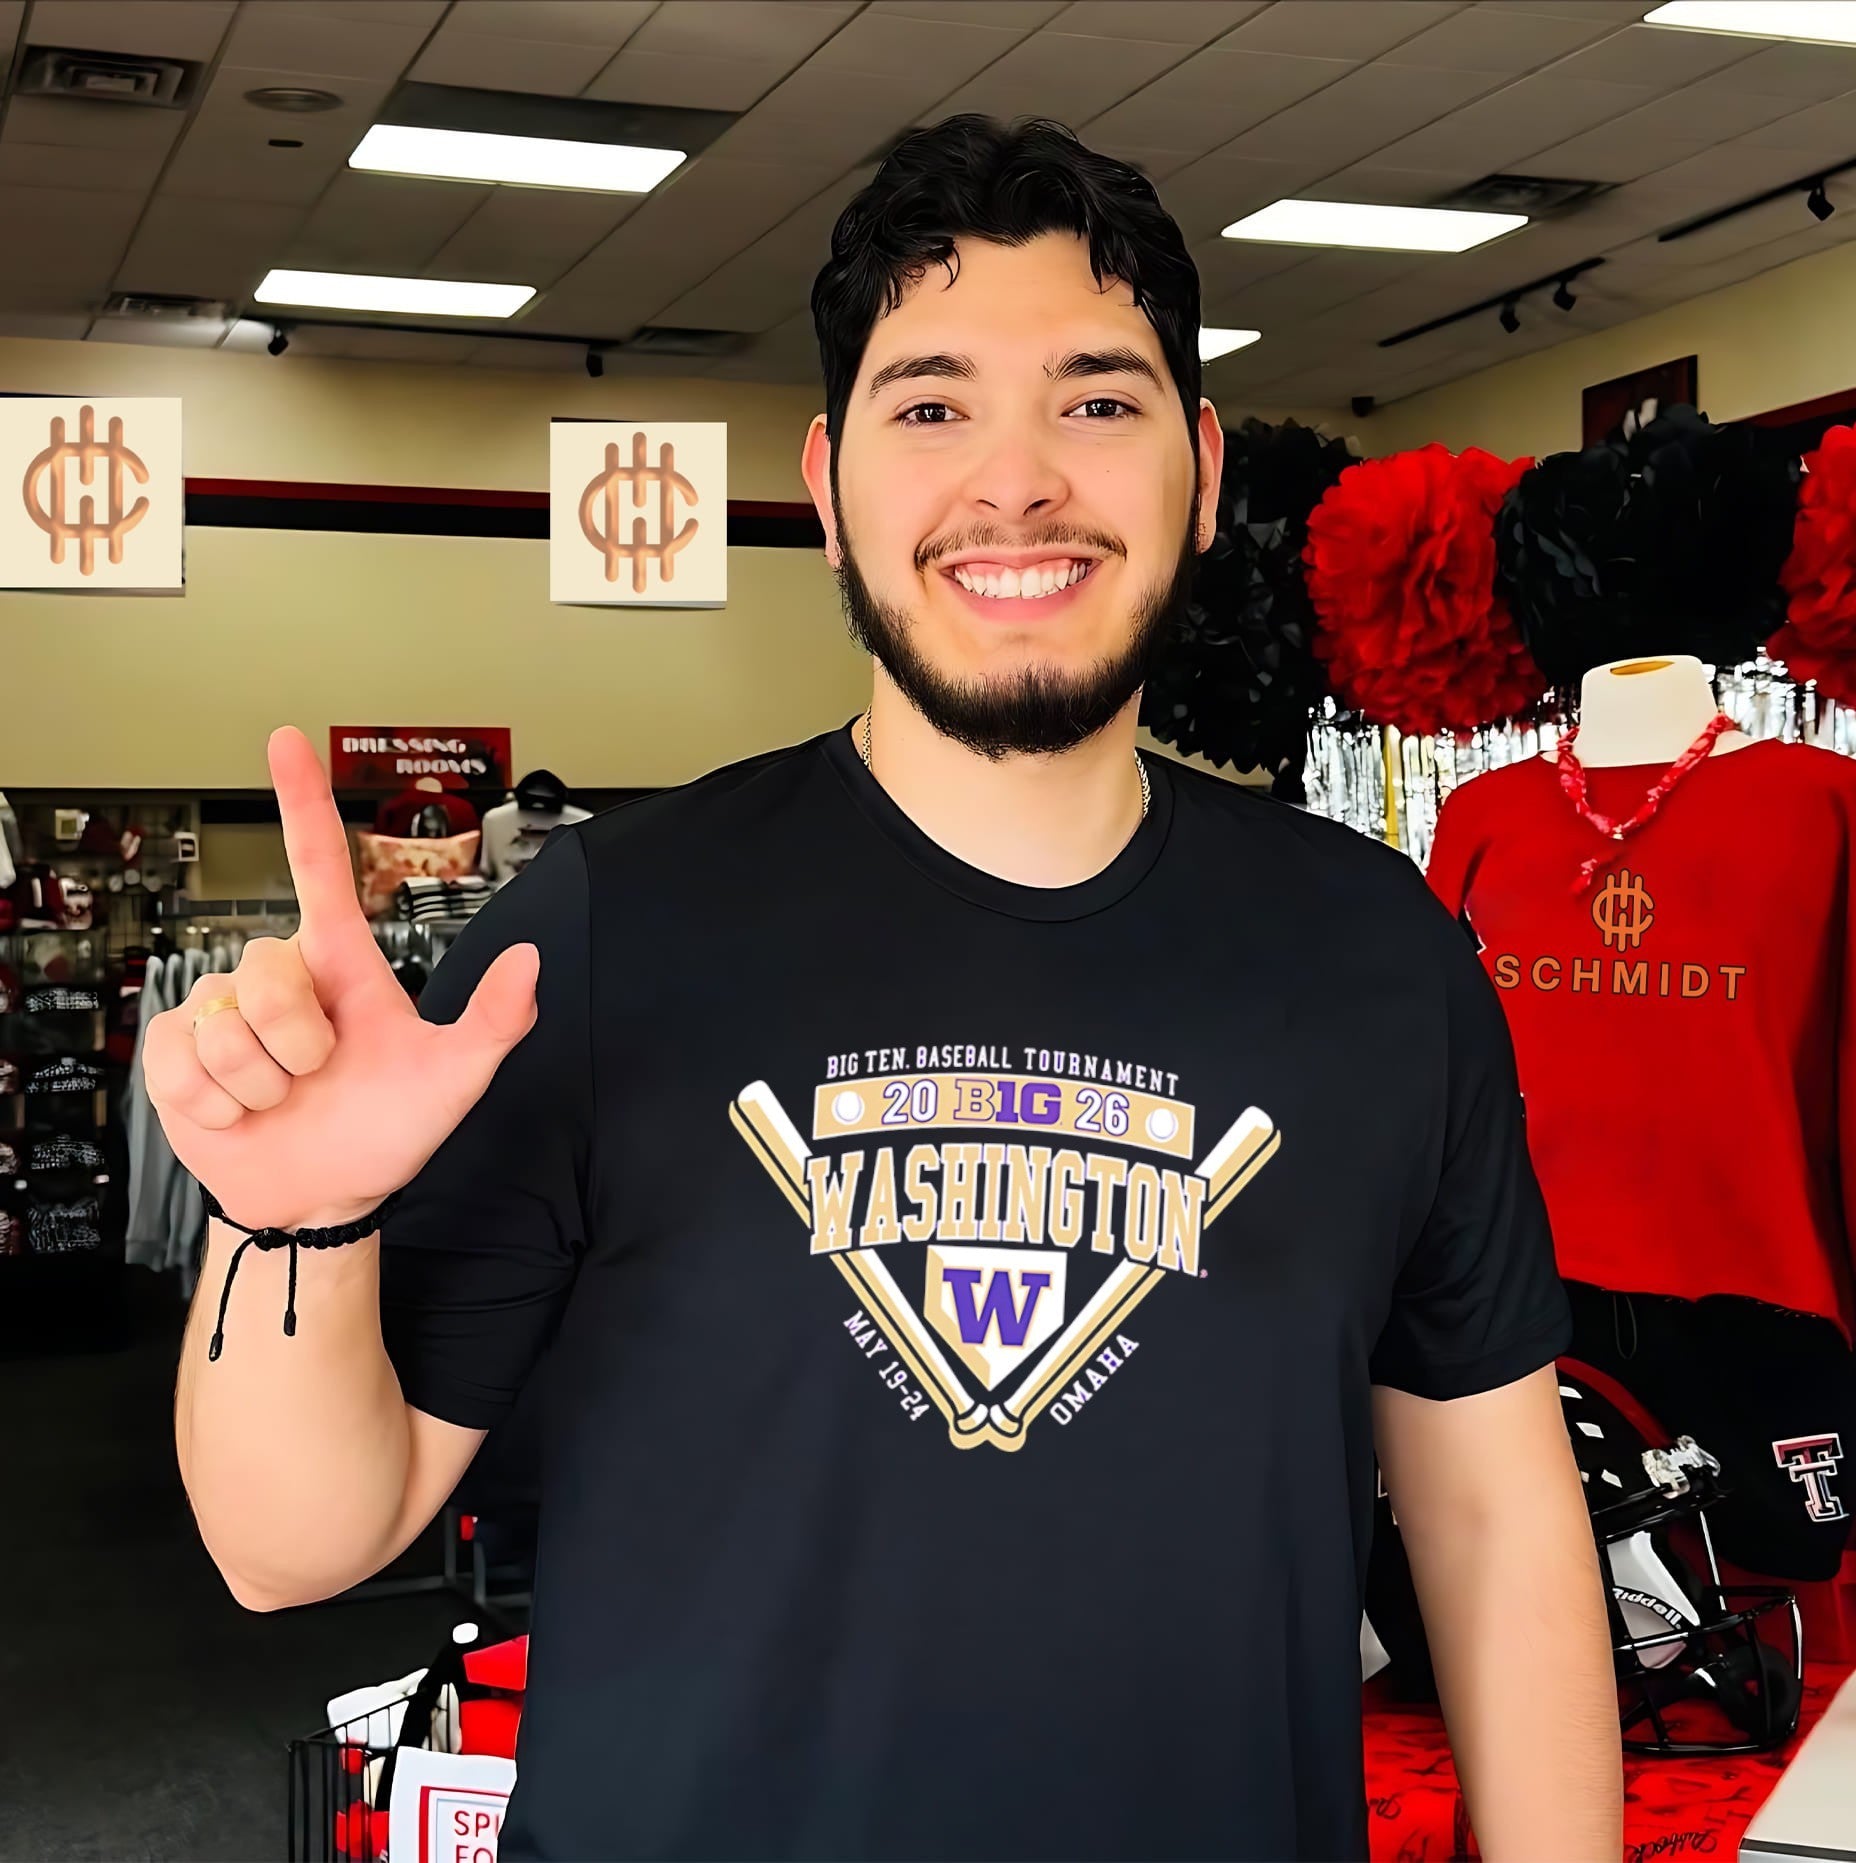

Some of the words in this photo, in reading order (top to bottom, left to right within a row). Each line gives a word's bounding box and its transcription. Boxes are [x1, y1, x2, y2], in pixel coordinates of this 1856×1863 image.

[1494, 954, 1747, 1000] SCHMIDT
[826, 1053, 859, 1079] BIG
[916, 1045, 1012, 1068] BASEBALL
[1024, 1047, 1179, 1097] TOURNAMENT
[881, 1078, 939, 1125] 20
[1074, 1087, 1130, 1137] 26
[805, 1142, 1206, 1277] WASHINGTON
[942, 1267, 1051, 1348] W
[843, 1310, 888, 1358] MAY
[879, 1361, 930, 1421] 19-24
[1050, 1334, 1139, 1425] OMAHA
